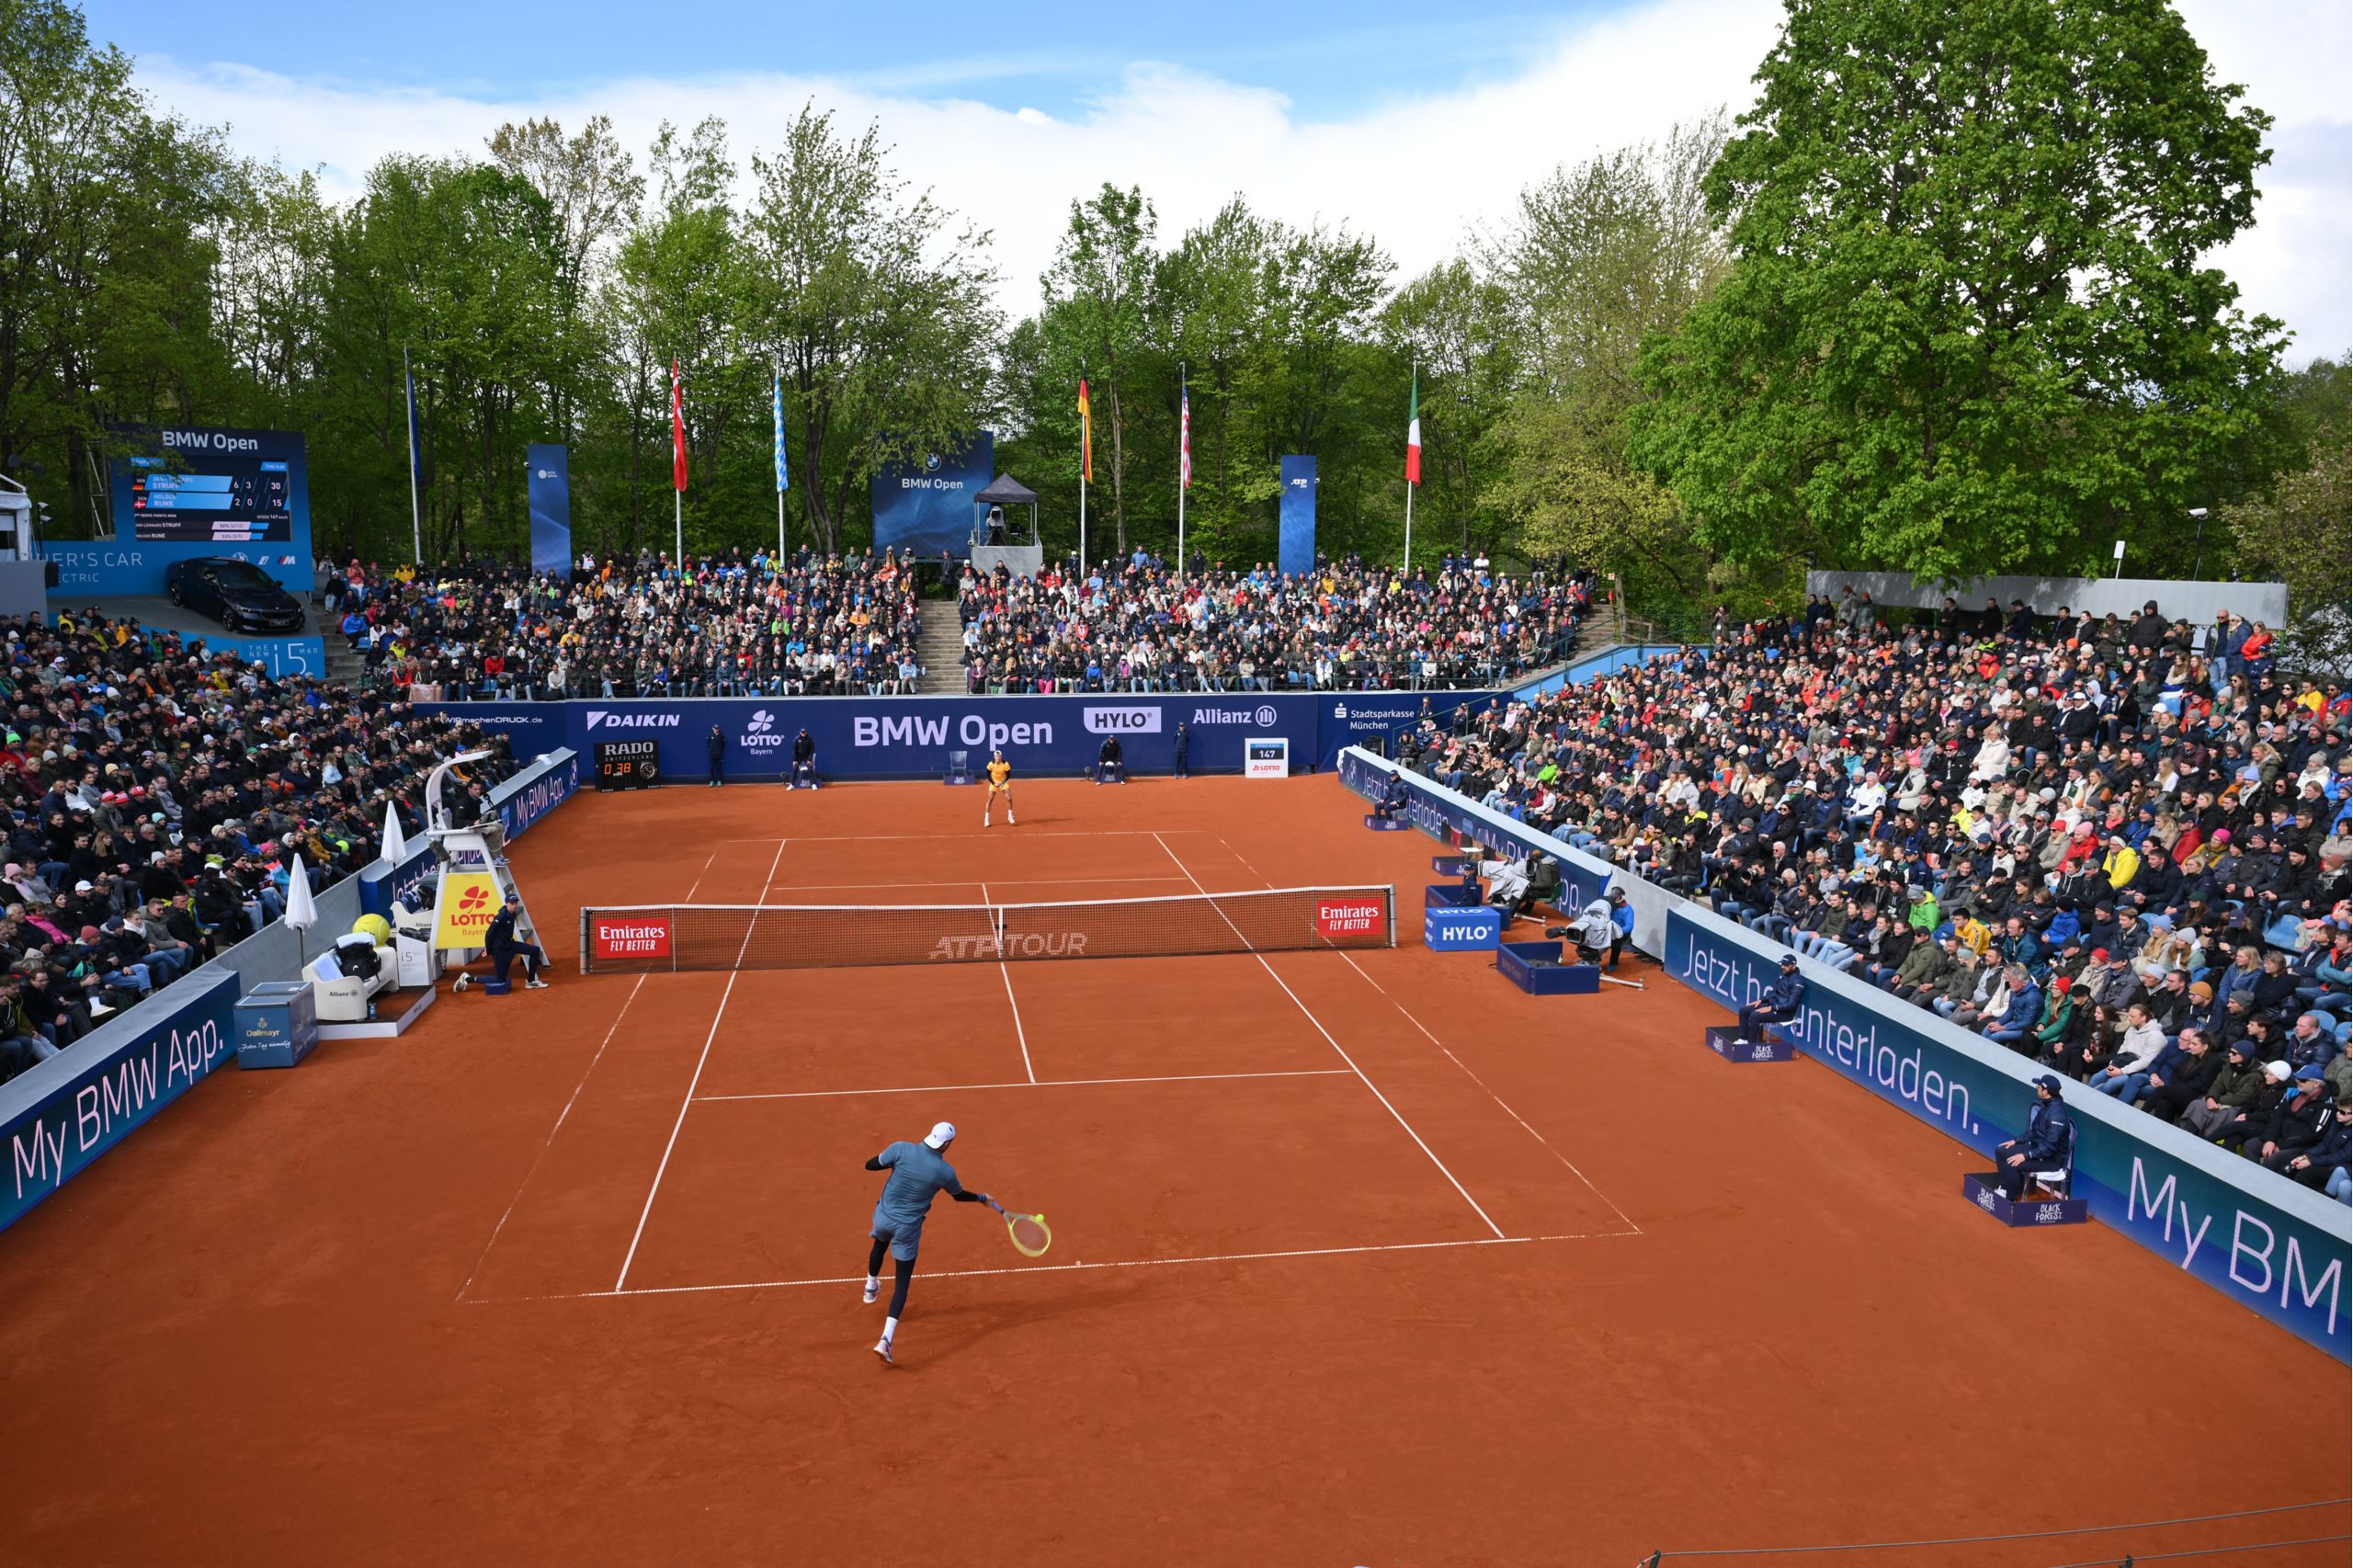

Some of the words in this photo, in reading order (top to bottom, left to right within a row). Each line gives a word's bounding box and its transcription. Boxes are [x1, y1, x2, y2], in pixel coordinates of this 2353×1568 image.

[162, 431, 209, 449] BMW
[213, 434, 258, 452] Open
[902, 478, 931, 489] BMW
[934, 478, 963, 491] Open
[104, 552, 142, 566] CAR
[59, 574, 99, 583] CTRIC
[605, 714, 680, 727] DAIKIN
[1193, 709, 1252, 723] Allianz
[1351, 710, 1415, 720] Stadtsparkasse
[1350, 722, 1388, 730] München
[741, 734, 781, 746] LOTTO
[855, 715, 949, 746] BMW
[960, 715, 1052, 752] Open
[605, 742, 654, 756] RADO
[750, 748, 773, 756] Bayern
[517, 795, 529, 829] My
[529, 789, 548, 818] BMW
[1321, 905, 1379, 919] Emirates
[451, 914, 495, 926] LOTTO
[1330, 920, 1342, 931] FLY
[1344, 919, 1370, 929] BETTER
[600, 925, 665, 939] Emirates
[610, 940, 624, 952] FLY
[626, 939, 656, 951] BETTER
[928, 935, 998, 959] ATP
[1005, 933, 1087, 956] TOUR
[1683, 934, 1739, 1002] Jetzt
[13, 1118, 66, 1199] My
[76, 1042, 156, 1153] BMW
[167, 1019, 223, 1088] App.
[2040, 1203, 2061, 1212] BLACK
[2036, 1211, 2063, 1221] FOREST
[2128, 1156, 2212, 1270] My
[2229, 1210, 2342, 1335] BM
